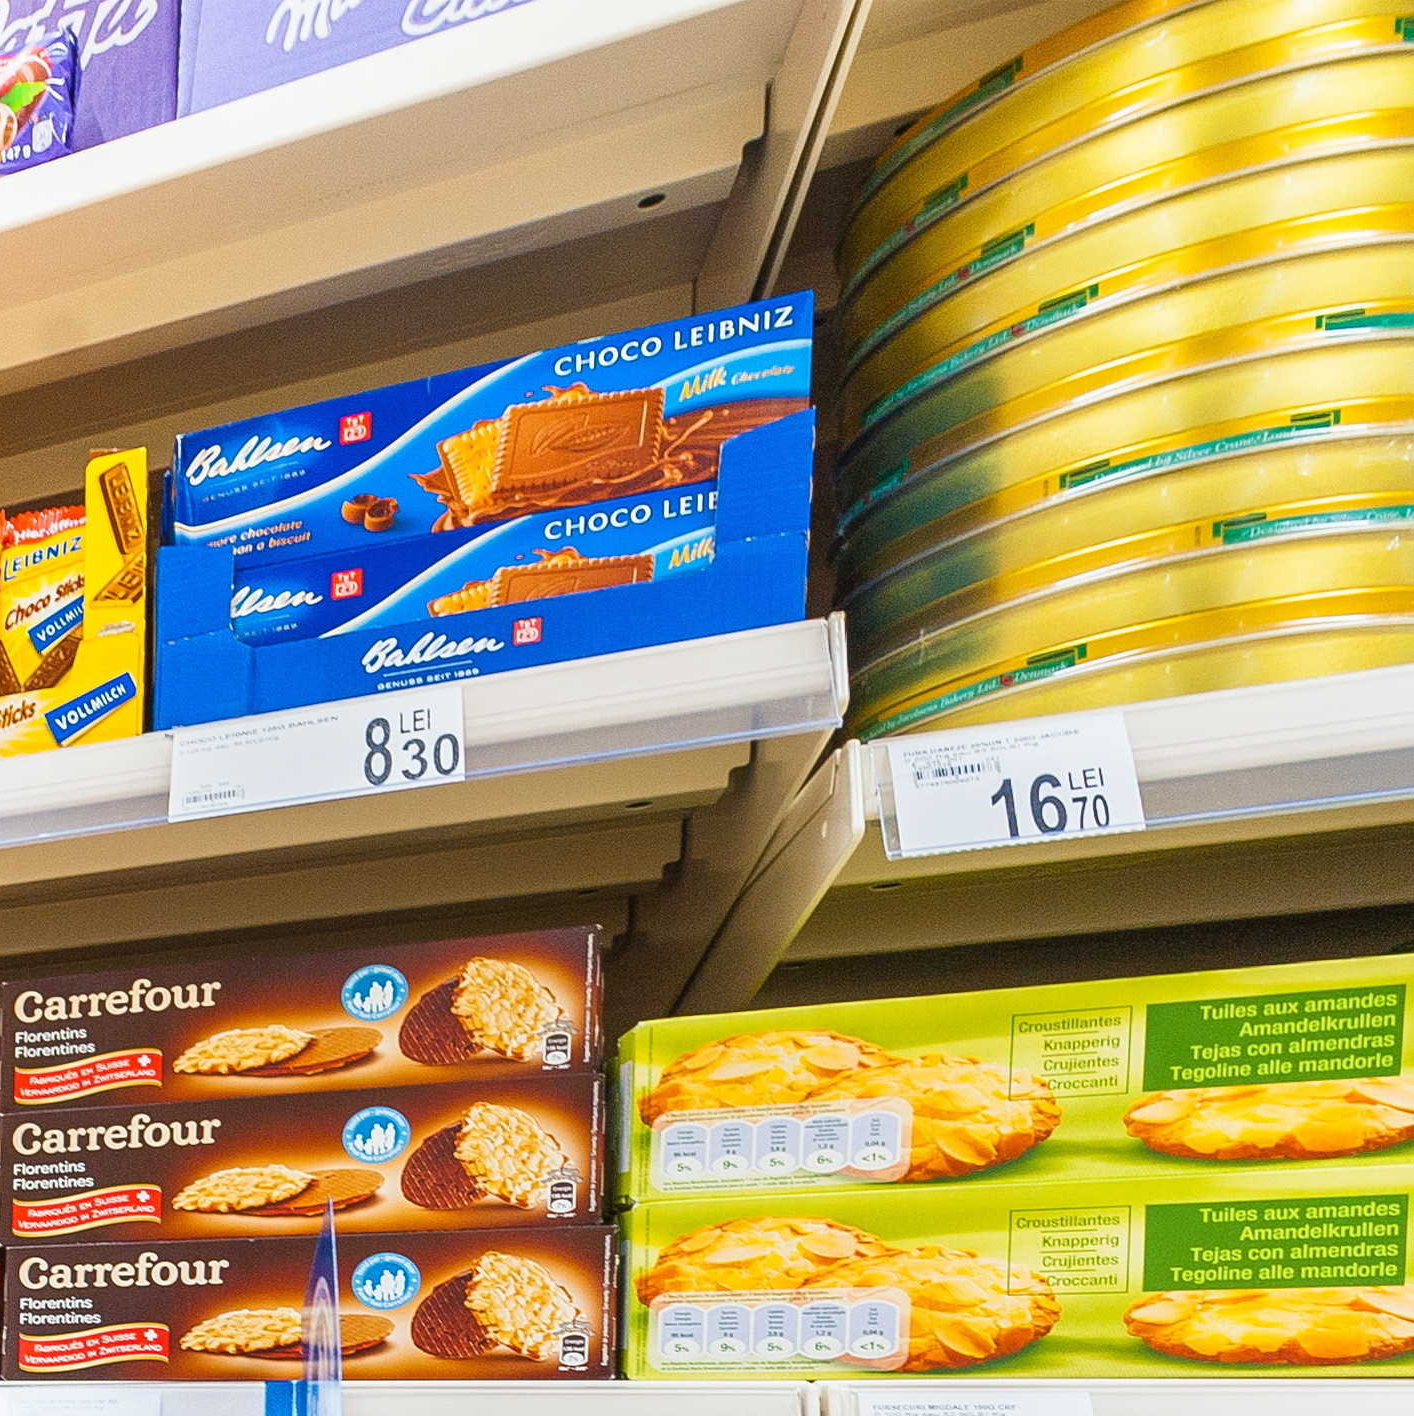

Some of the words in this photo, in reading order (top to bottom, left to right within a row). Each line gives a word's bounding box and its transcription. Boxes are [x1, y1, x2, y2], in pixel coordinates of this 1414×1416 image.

[554, 336, 662, 377] CHOCO
[673, 306, 794, 352] LEIBNIZ
[678, 367, 727, 402] Milk
[186, 435, 331, 486] Bahlsen
[241, 520, 302, 542] chocolate
[268, 532, 311, 548] biscuit
[362, 632, 504, 675] Bahlsen
[54, 680, 127, 731] VOLLMILCH
[364, 717, 393, 786] 8
[399, 708, 431, 735] LEI
[401, 733, 461, 782] 30
[991, 773, 1067, 839] 16
[1068, 768, 1104, 790] LEI
[1072, 794, 1110, 830] 70
[14, 978, 221, 1024] Carrefour
[1200, 1002, 1259, 1021] Tuiles
[1264, 999, 1299, 1016] aux
[1303, 991, 1398, 1014] amandes
[14, 1026, 88, 1043] Florentins
[1018, 1013, 1122, 1034] Croustillantes
[1239, 1012, 1397, 1037] Amandelkrullen
[14, 1041, 96, 1059] Florentines
[1043, 1034, 1121, 1054] Knapperig
[1191, 1041, 1241, 1062] Tejas
[1245, 1039, 1285, 1056] con
[1289, 1032, 1395, 1054] almendras
[1043, 1053, 1120, 1072] Crujientes
[1170, 1063, 1252, 1084] Tegoline
[1257, 1058, 1295, 1076] alle
[1299, 1052, 1394, 1074] mandorle
[1046, 1072, 1119, 1092] Croccanti
[19, 1252, 229, 1290] Carrefour
